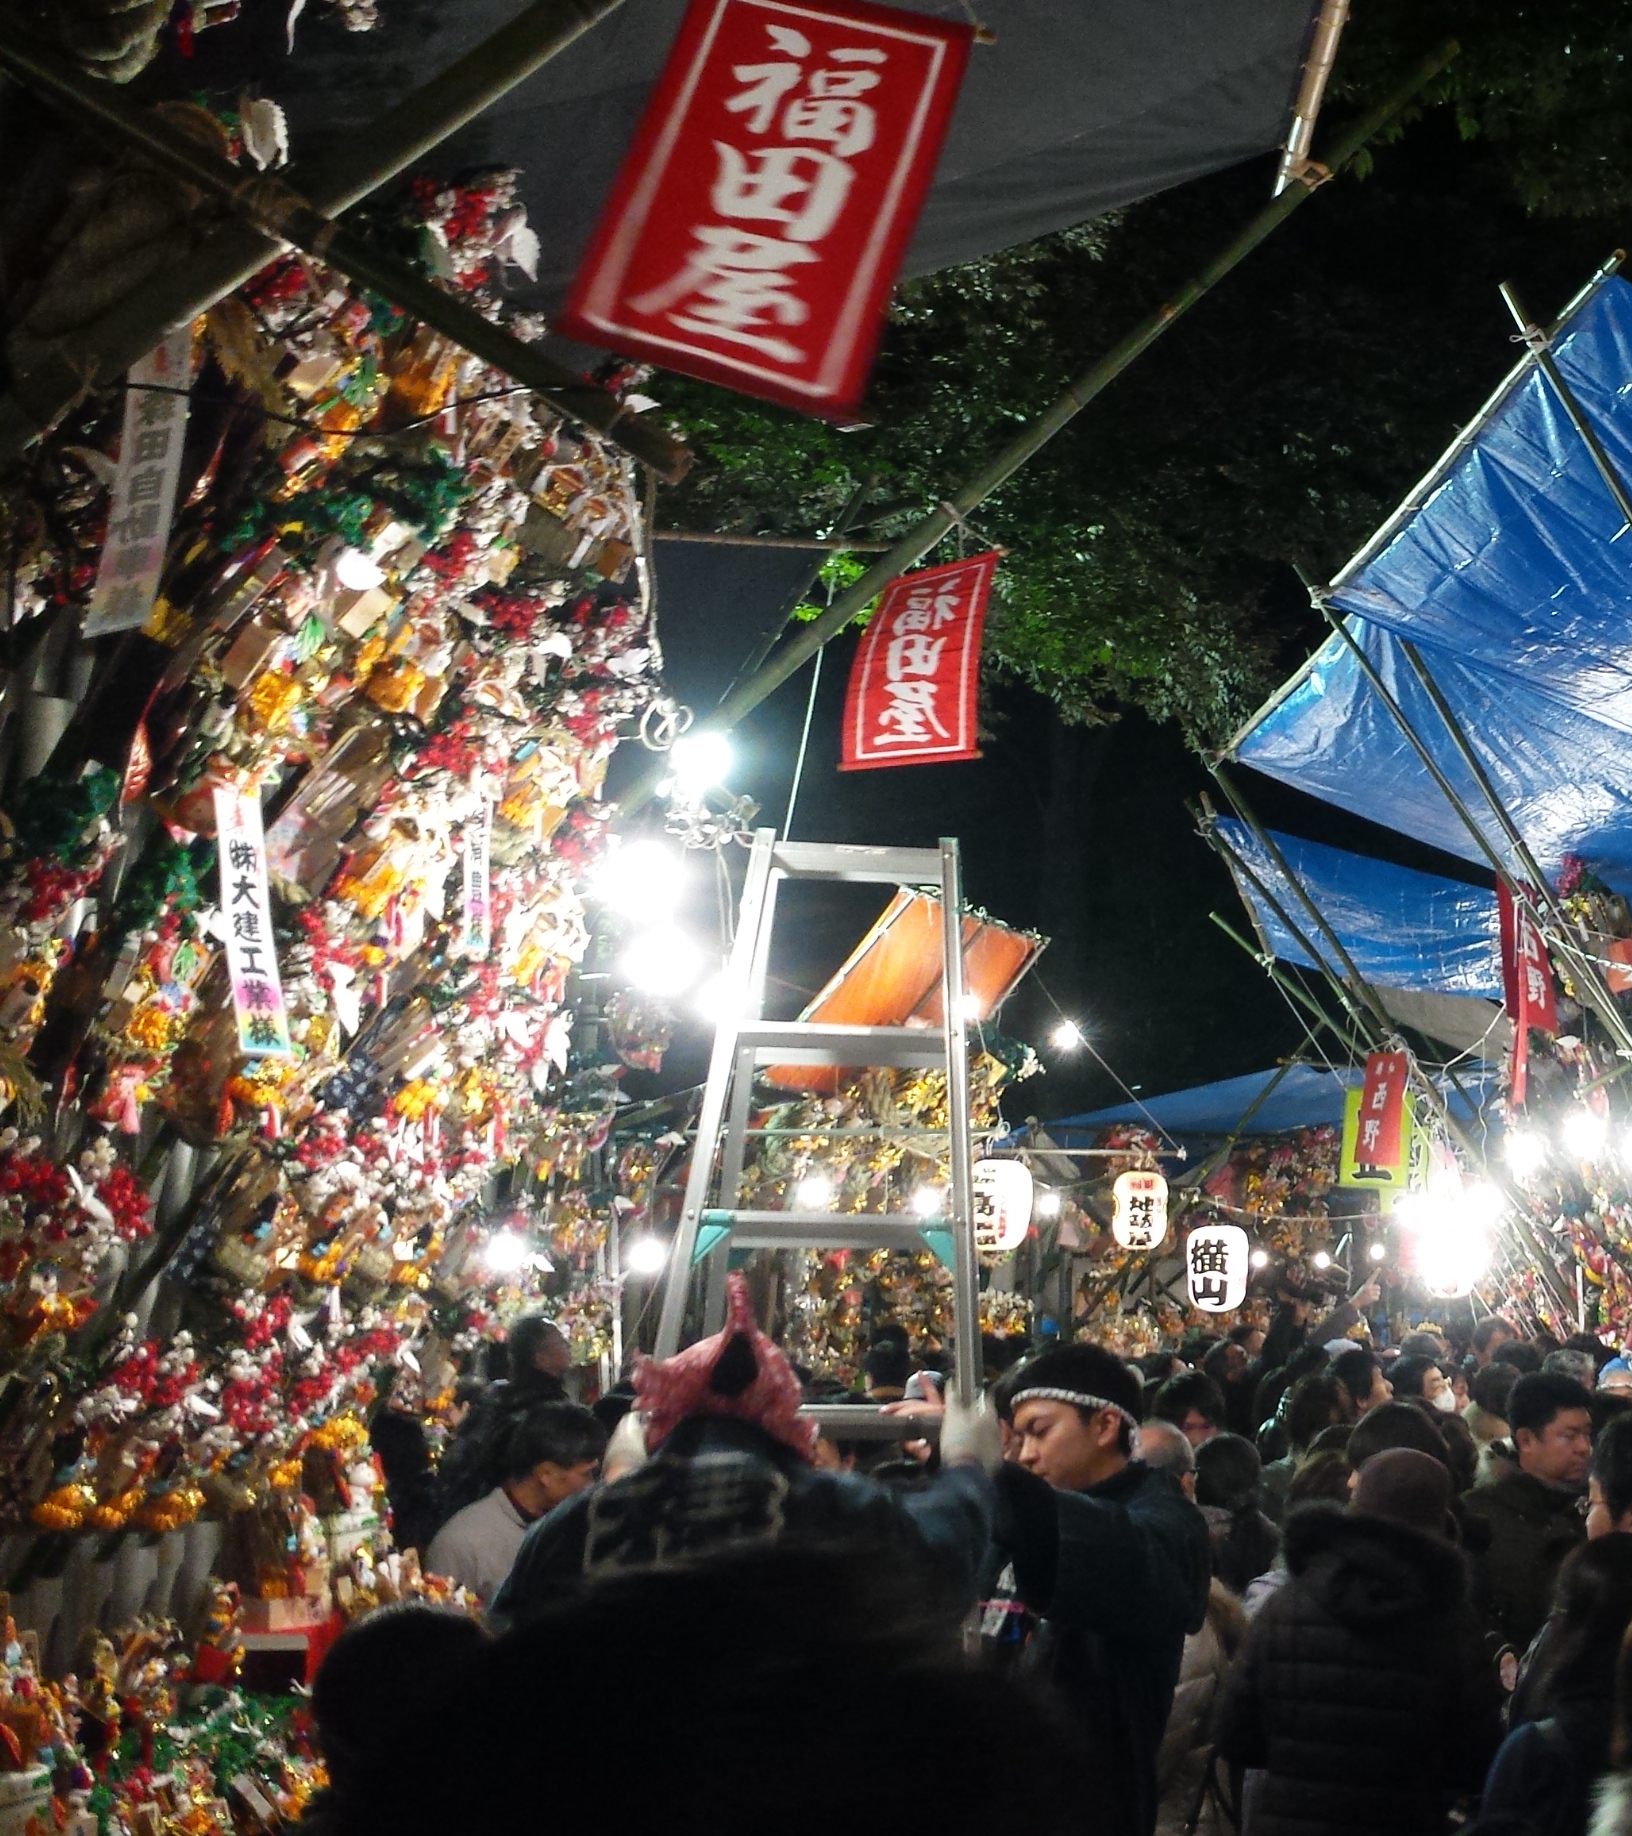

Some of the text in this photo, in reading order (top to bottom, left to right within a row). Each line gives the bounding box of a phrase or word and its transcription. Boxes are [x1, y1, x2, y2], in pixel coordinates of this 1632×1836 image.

[626, 23, 889, 363] 福田屋
[1191, 1239, 1229, 1306] 横山
